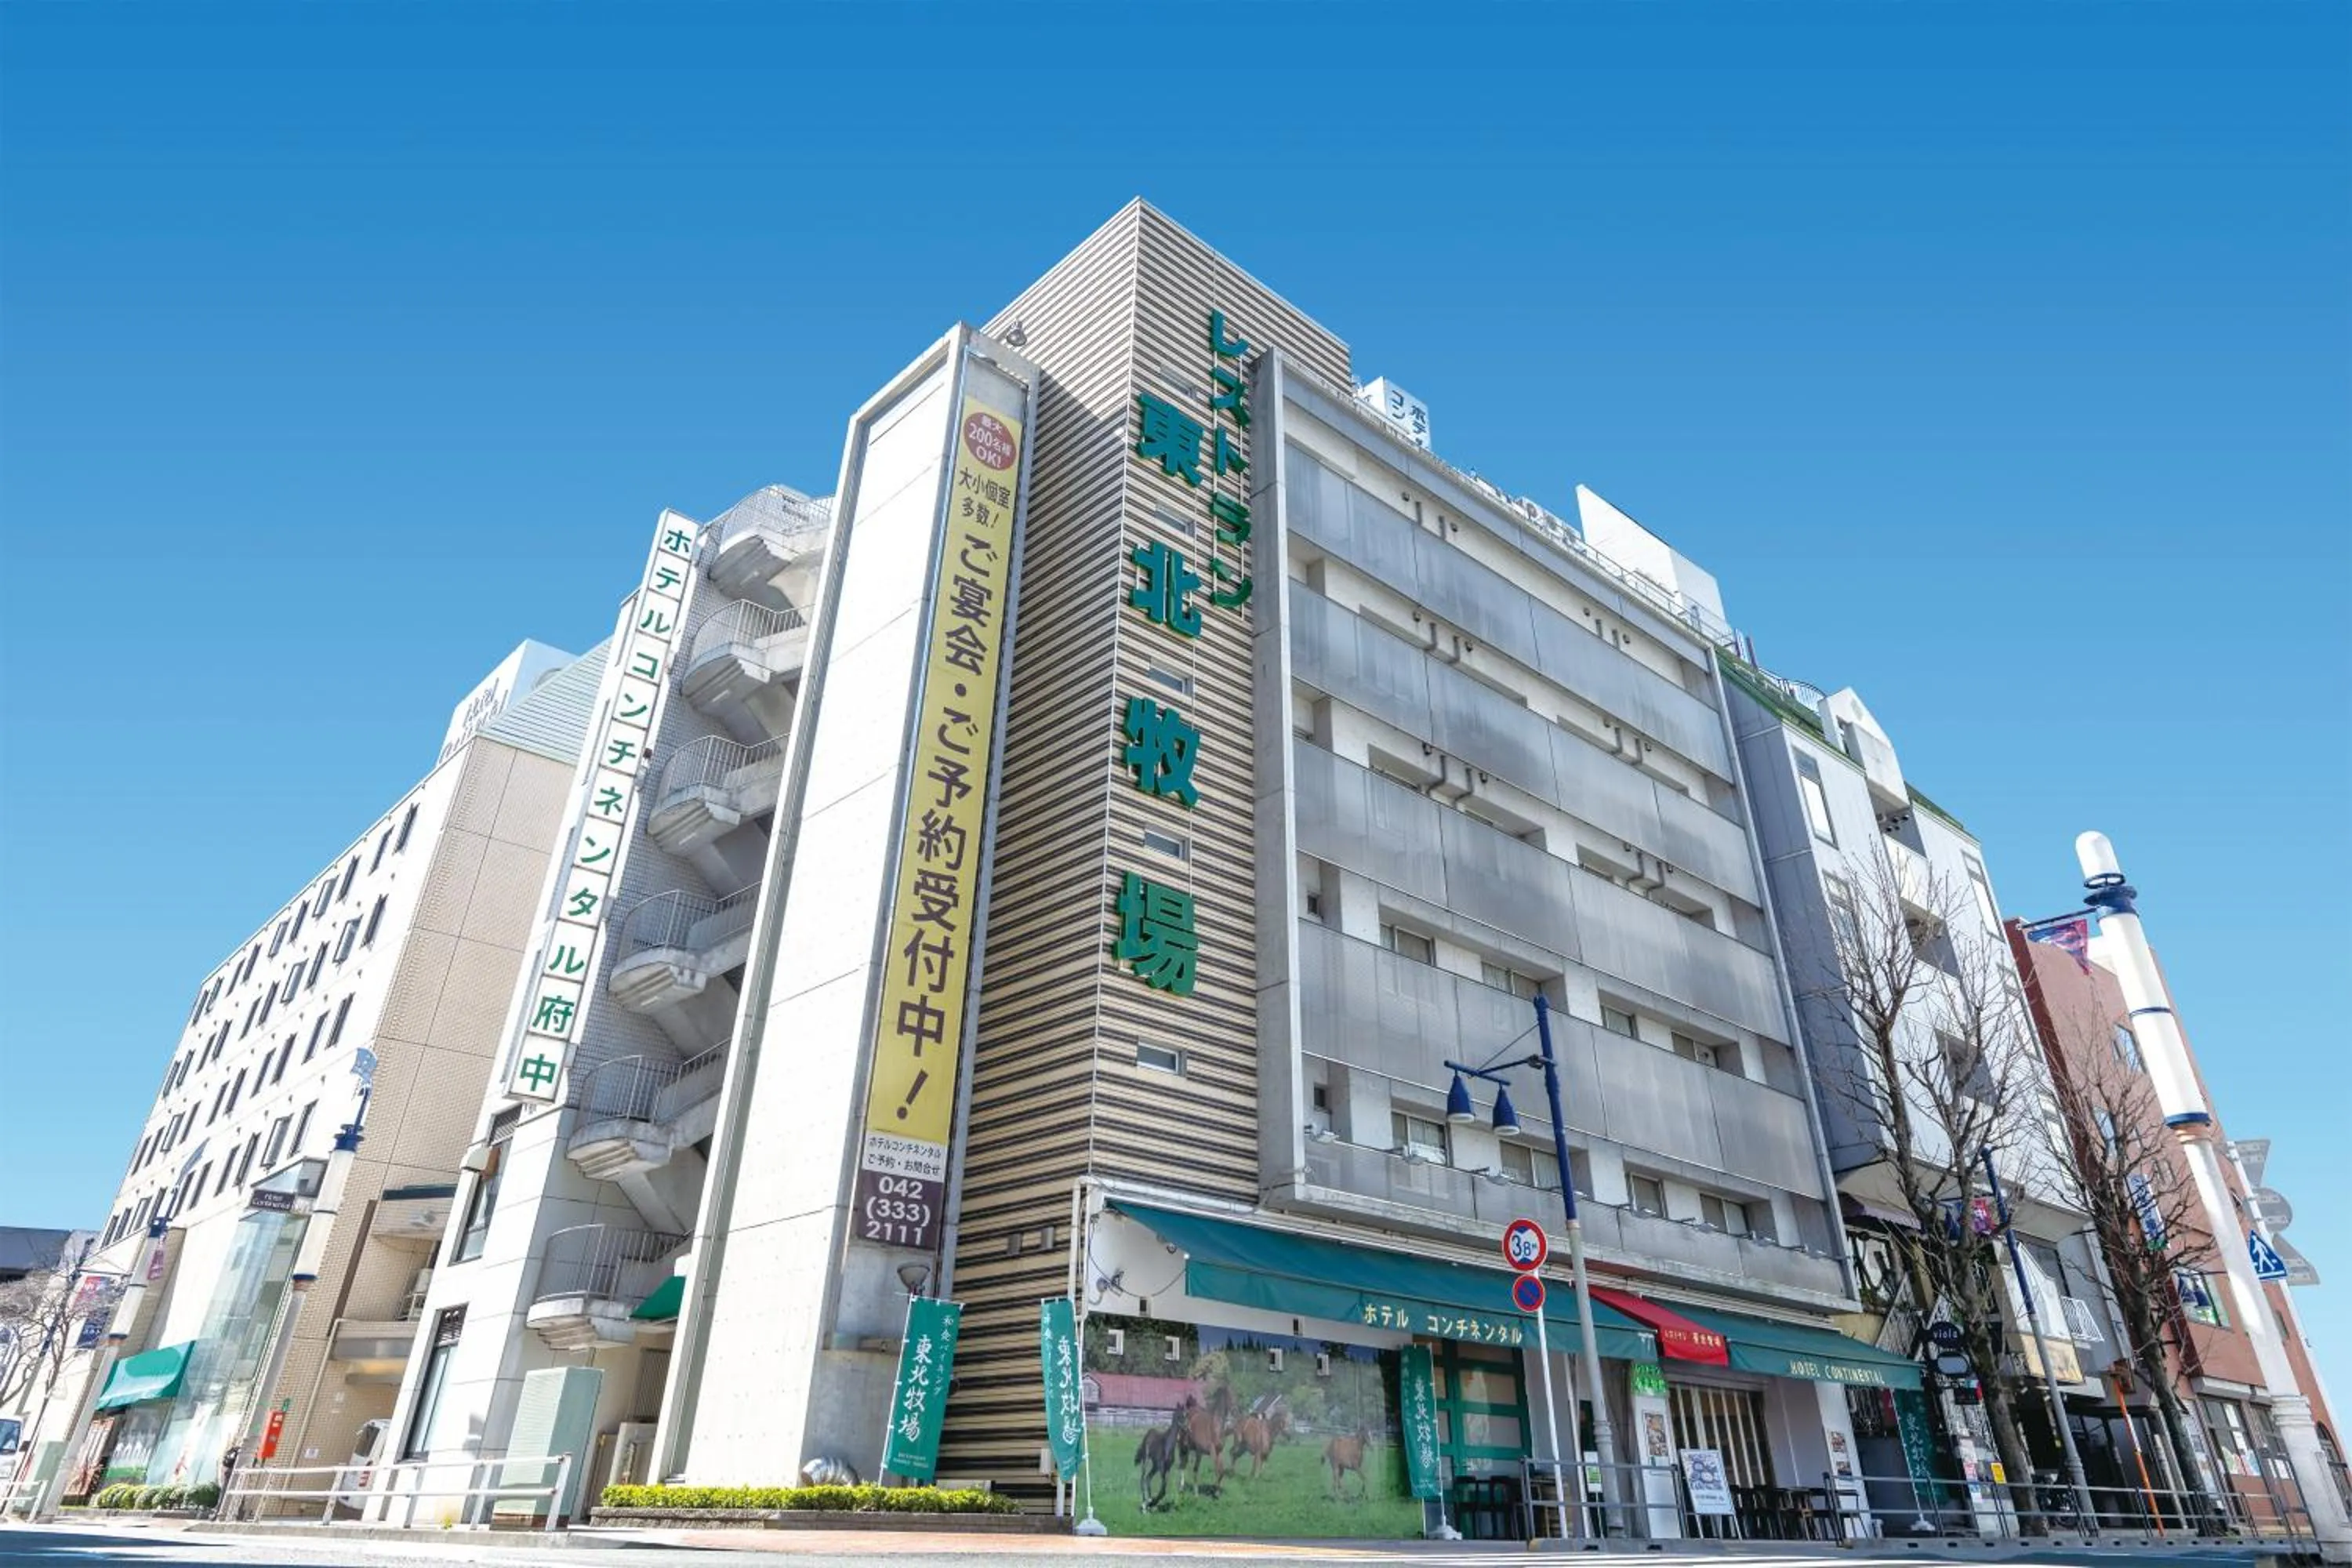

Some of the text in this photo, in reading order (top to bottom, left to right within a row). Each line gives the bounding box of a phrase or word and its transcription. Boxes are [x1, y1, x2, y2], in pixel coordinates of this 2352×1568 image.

[1210, 308, 1252, 608] レストラン
[959, 466, 1011, 510] 大小個室
[1113, 392, 1203, 999] 東北牧場
[520, 528, 695, 1093] ホテルコンチネンタル府中
[869, 1137, 942, 1160] ホテルコンチネンタル
[878, 1176, 924, 1200] 042
[866, 1196, 931, 1228] (333)
[866, 1220, 924, 1247] 2111
[1364, 1303, 1523, 1345] ホテル コンチネンタル
[898, 1334, 933, 1443] 東北牧場
